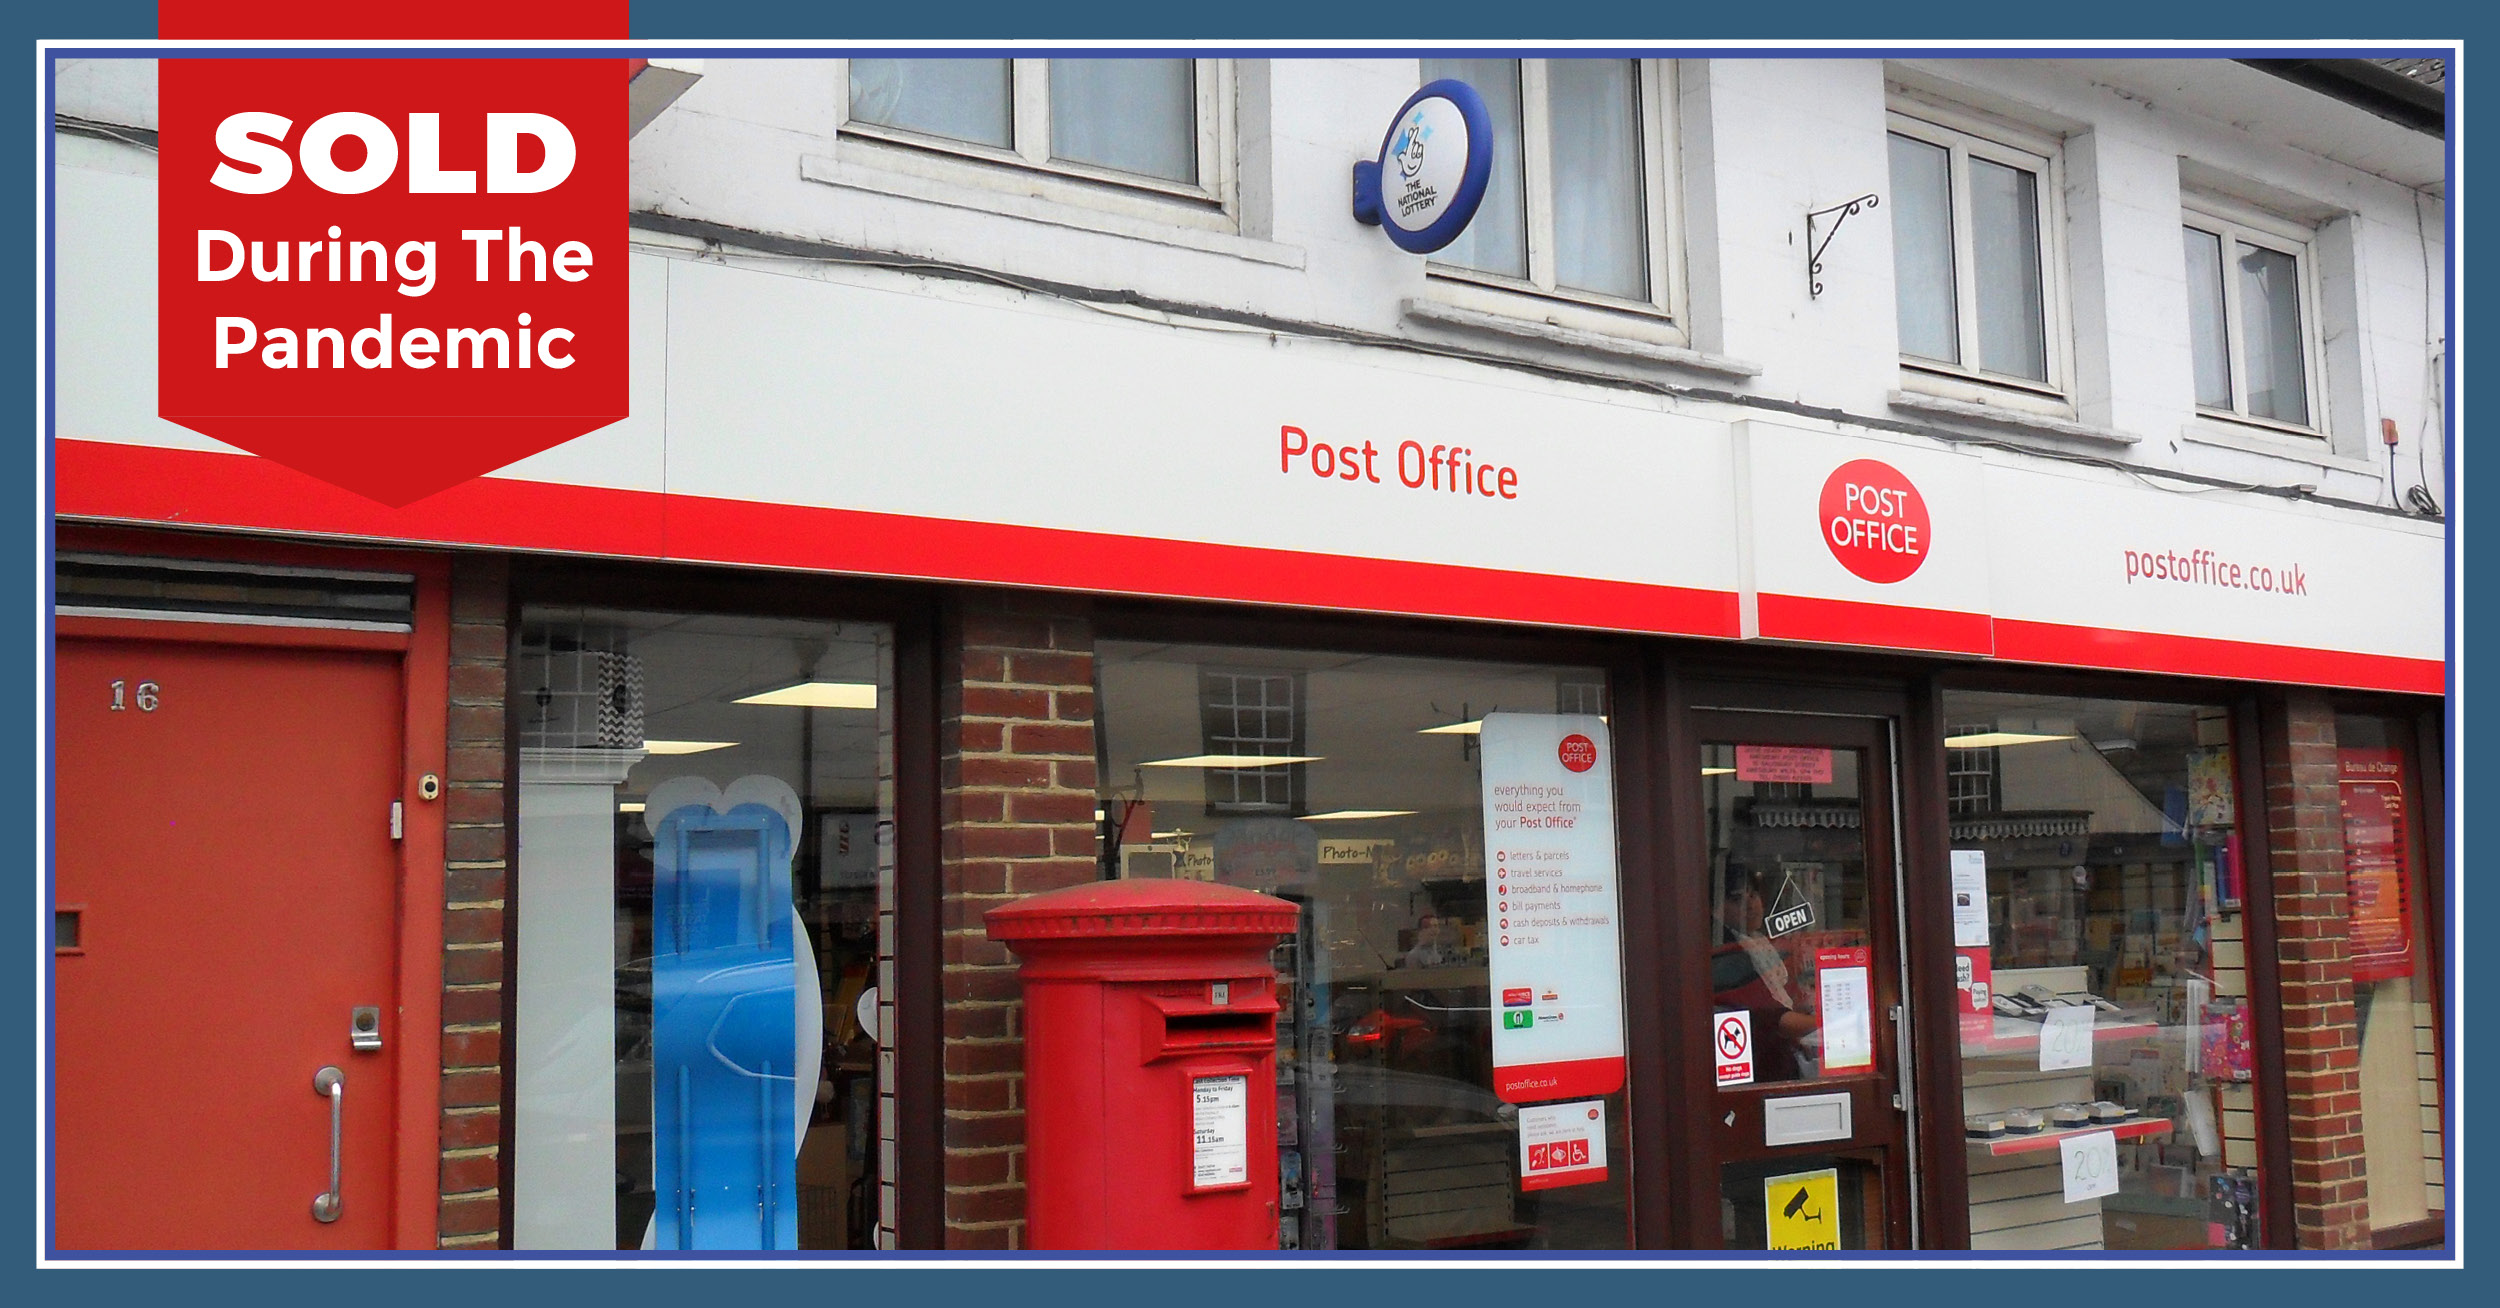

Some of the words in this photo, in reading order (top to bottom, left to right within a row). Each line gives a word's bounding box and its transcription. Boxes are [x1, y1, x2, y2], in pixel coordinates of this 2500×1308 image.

[1405, 179, 1421, 193] THE
[1398, 185, 1437, 207] NATIONAL
[1401, 196, 1436, 217] LOTTERY
[1281, 425, 1380, 483] Post
[1398, 440, 1517, 499] Office
[1845, 483, 1907, 519] POST
[1831, 517, 1919, 555] OFFICE
[2125, 549, 2307, 596] postoffice.co.uk
[110, 679, 159, 712] 16
[1567, 742, 1588, 752] POST
[1562, 753, 1592, 763] OFFICE
[2345, 761, 2367, 772] Bureau
[2368, 762, 2376, 772] de
[2376, 761, 2398, 774] Change
[1495, 784, 1544, 798] everything
[1547, 786, 1563, 797] you
[1495, 800, 1523, 812] would
[1527, 802, 1556, 814] expect
[1559, 801, 1581, 812] from
[1495, 818, 1516, 830] your
[1520, 816, 1542, 828] Post
[1510, 851, 1534, 860] letters
[1536, 851, 1541, 860] &
[1544, 851, 1569, 861] parcels
[1511, 868, 1532, 878] travel
[1534, 869, 1563, 878] services
[1512, 884, 1550, 894] broadband
[1553, 884, 1559, 893] &
[1560, 884, 1603, 895] homephone
[1512, 901, 1523, 910] bill
[1525, 902, 1561, 912] payments
[1513, 919, 1529, 928] cash
[1531, 917, 1560, 929] deposits
[1562, 917, 1567, 926] &
[1569, 915, 1610, 926] withdrawals
[1775, 909, 1807, 932] OPEN
[1514, 936, 1525, 945] car
[1527, 936, 1540, 945] tax
[1506, 1077, 1557, 1092] postoffice.co.uk
[1196, 1135, 1224, 1144] 11.15am
